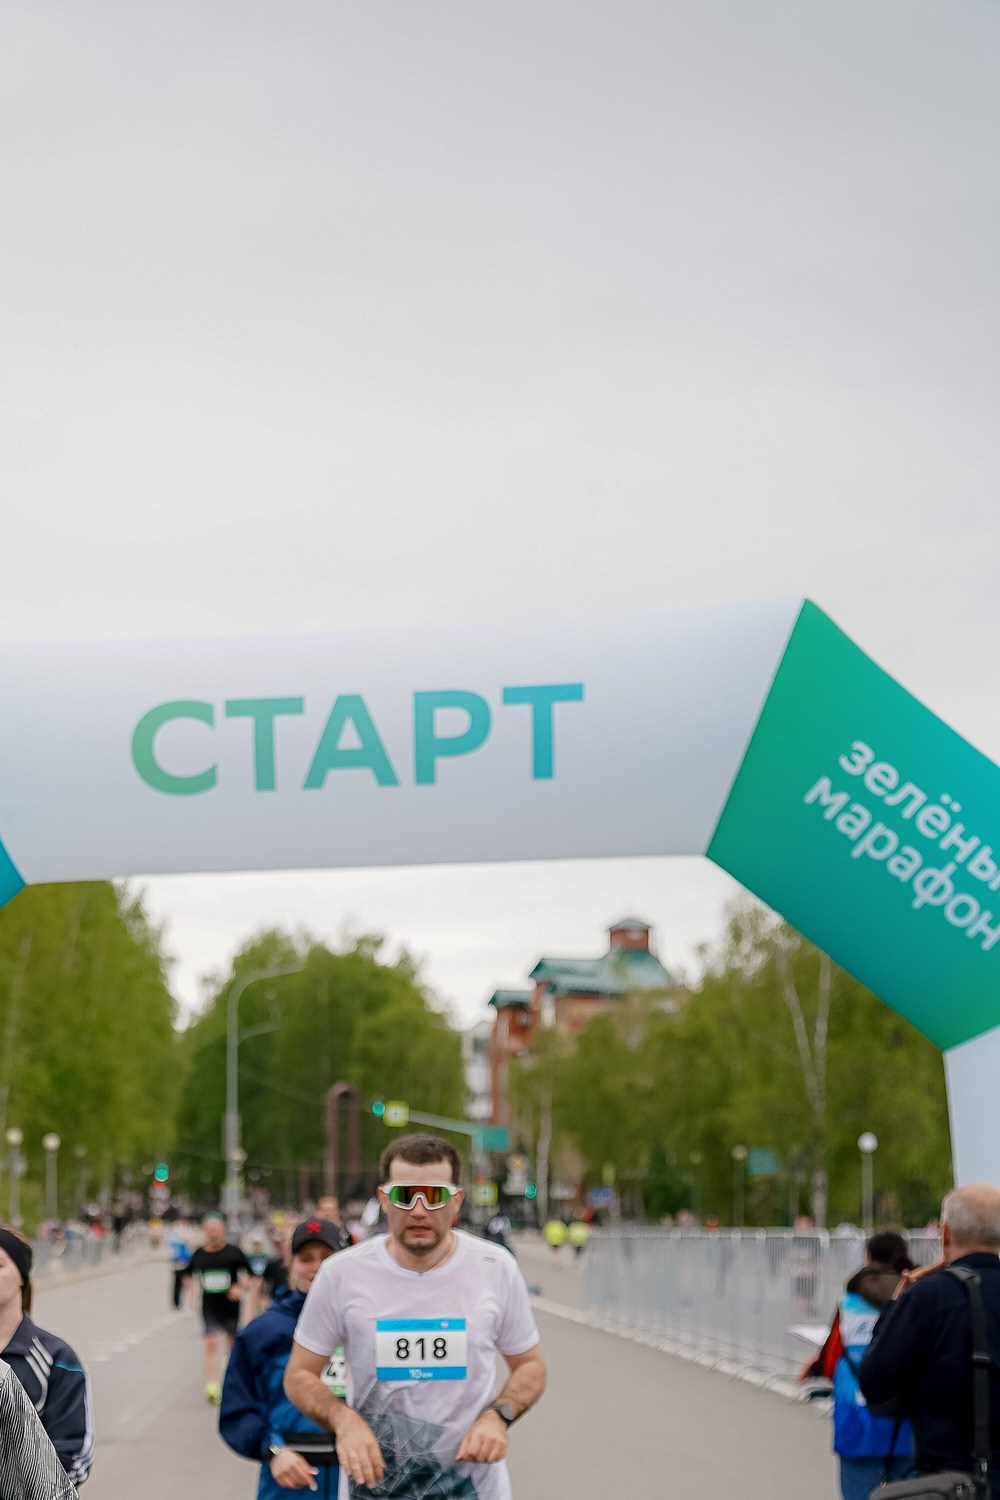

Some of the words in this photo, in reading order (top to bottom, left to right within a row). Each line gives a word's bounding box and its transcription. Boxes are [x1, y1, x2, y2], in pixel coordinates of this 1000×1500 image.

[131, 683, 584, 796] СТАРТ
[803, 775, 1000, 951] марафон
[838, 739, 1000, 891] зелёны
[396, 1338, 447, 1360] 818
